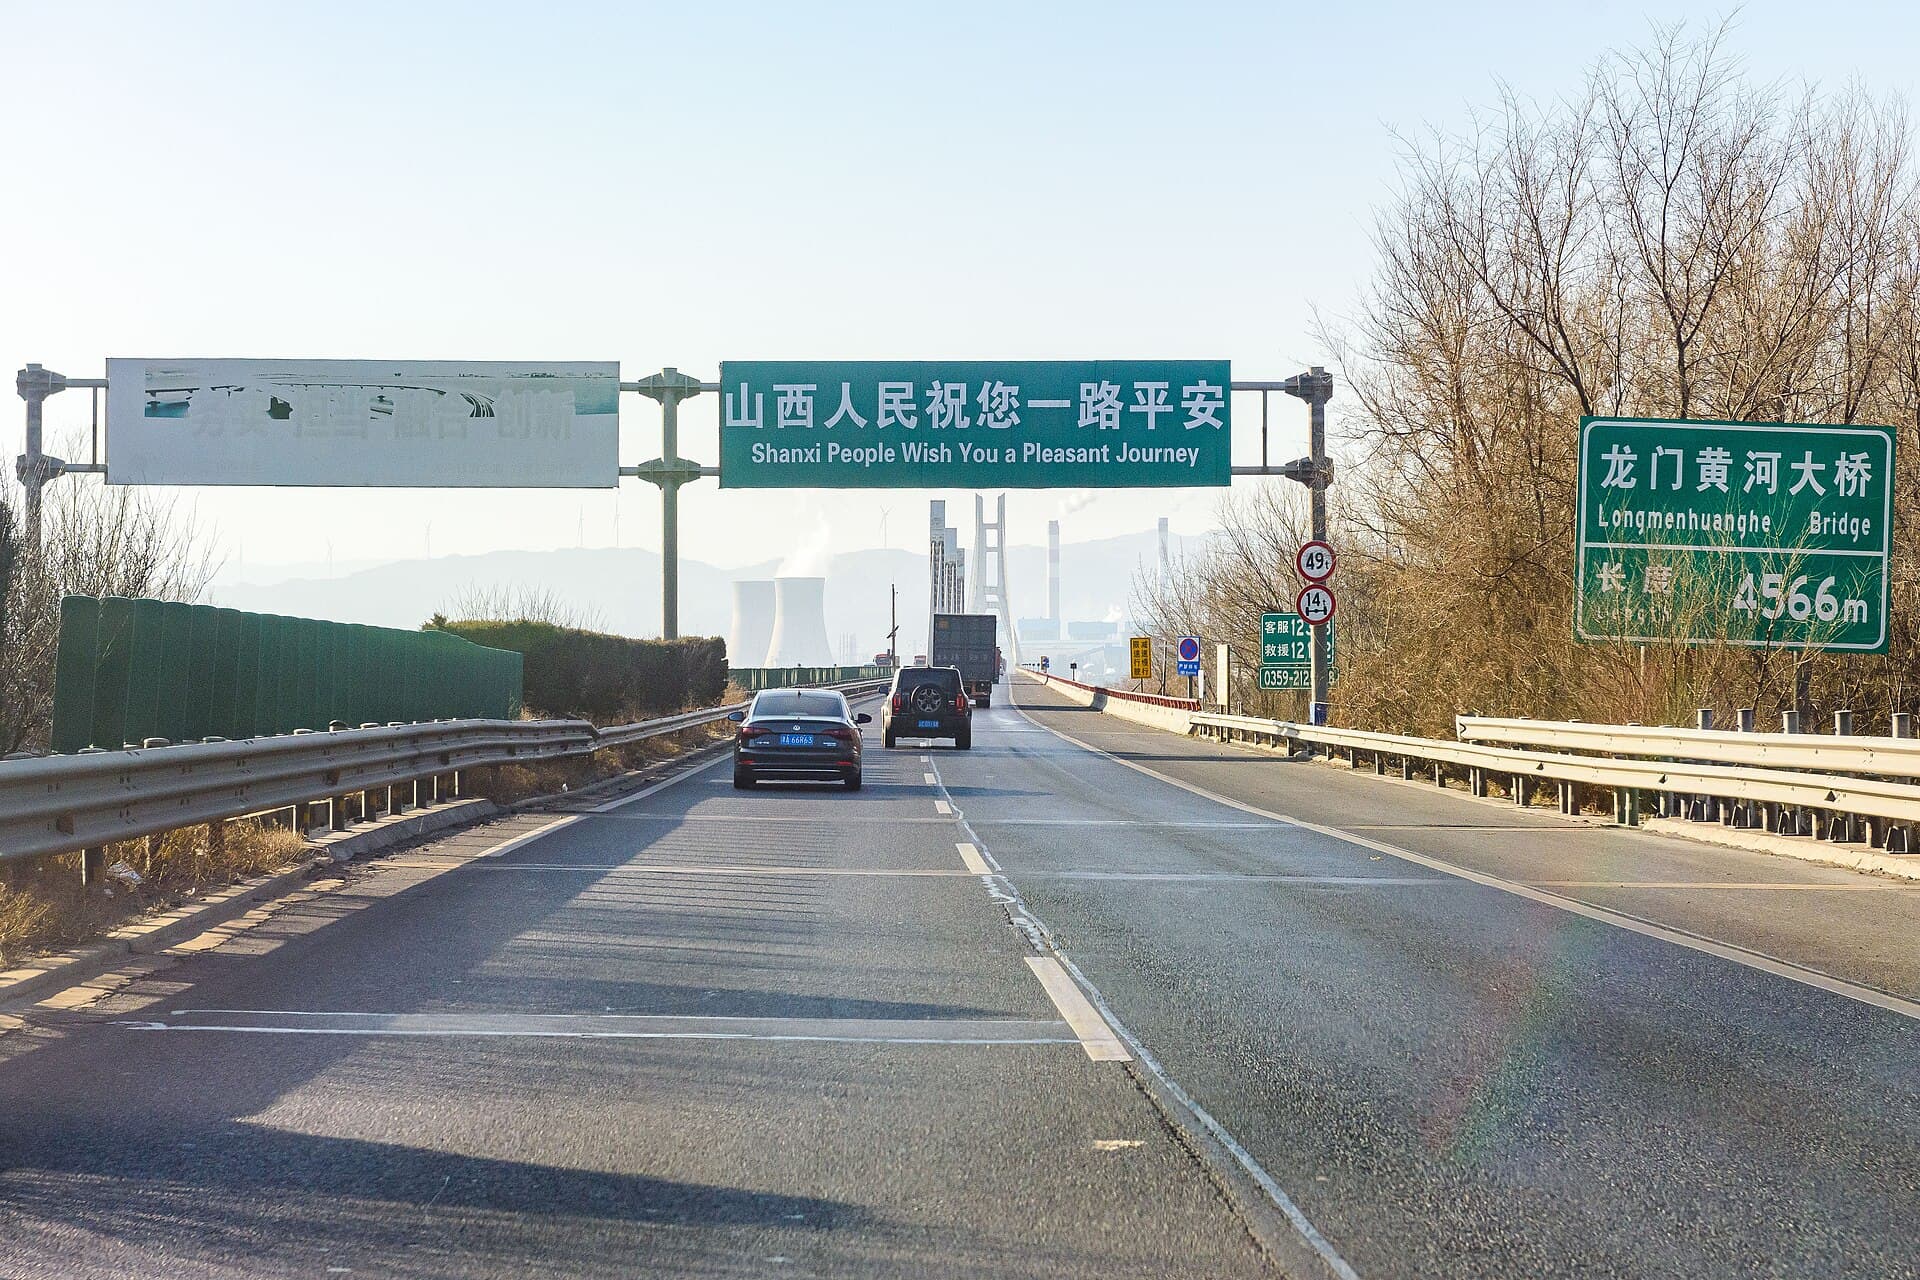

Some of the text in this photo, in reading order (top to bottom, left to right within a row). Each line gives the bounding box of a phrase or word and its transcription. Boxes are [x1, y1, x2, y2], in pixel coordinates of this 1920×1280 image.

[725, 379, 1225, 430] 山西人民祝您一路平安
[751, 442, 1200, 468] Shanxi People Wish You a Pleasant Journey
[1600, 444, 1872, 498] 龙门黄河大桥
[1598, 503, 1872, 543] Longmenhuanghe Bridge
[1264, 620, 1289, 634] 客服
[1264, 643, 1289, 657] 救援
